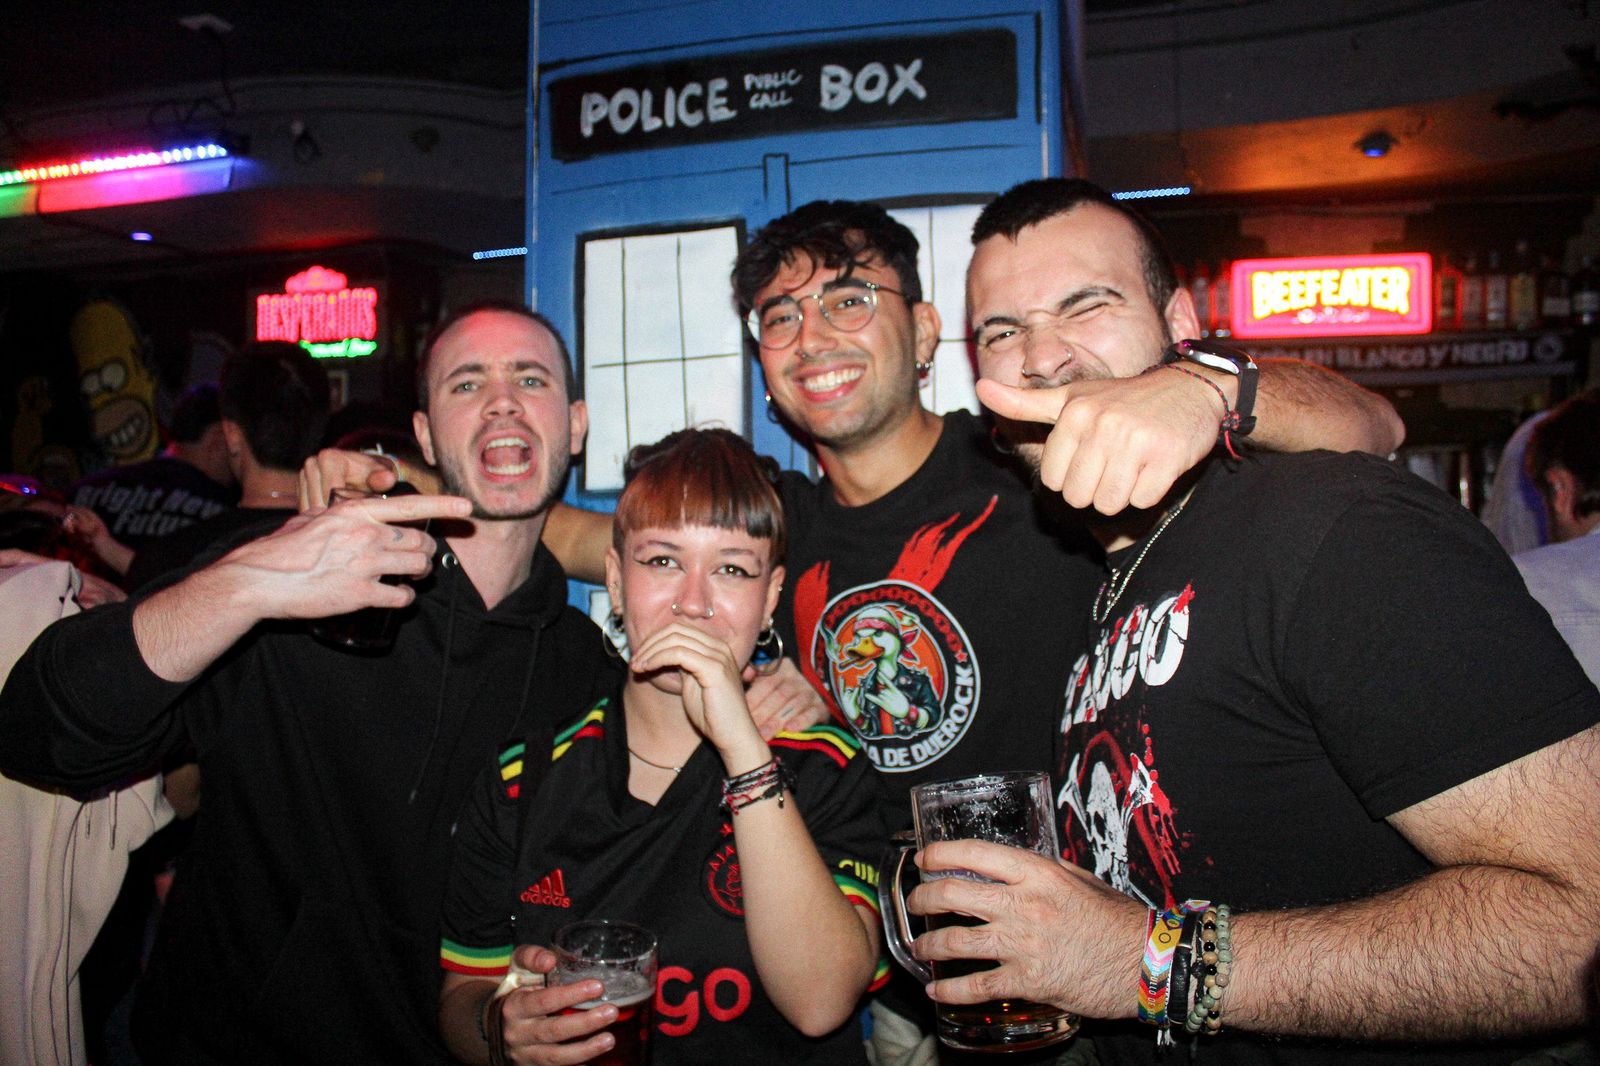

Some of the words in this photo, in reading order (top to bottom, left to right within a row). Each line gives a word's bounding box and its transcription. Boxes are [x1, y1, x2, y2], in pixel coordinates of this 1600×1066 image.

[743, 68, 802, 92] PUBLIC
[580, 78, 737, 138] POLICE
[819, 58, 927, 111] BOX
[748, 92, 793, 109] CALL
[1250, 265, 1411, 320] BEEFEATER
[882, 746, 913, 768] DE
[708, 844, 738, 873] AJA
